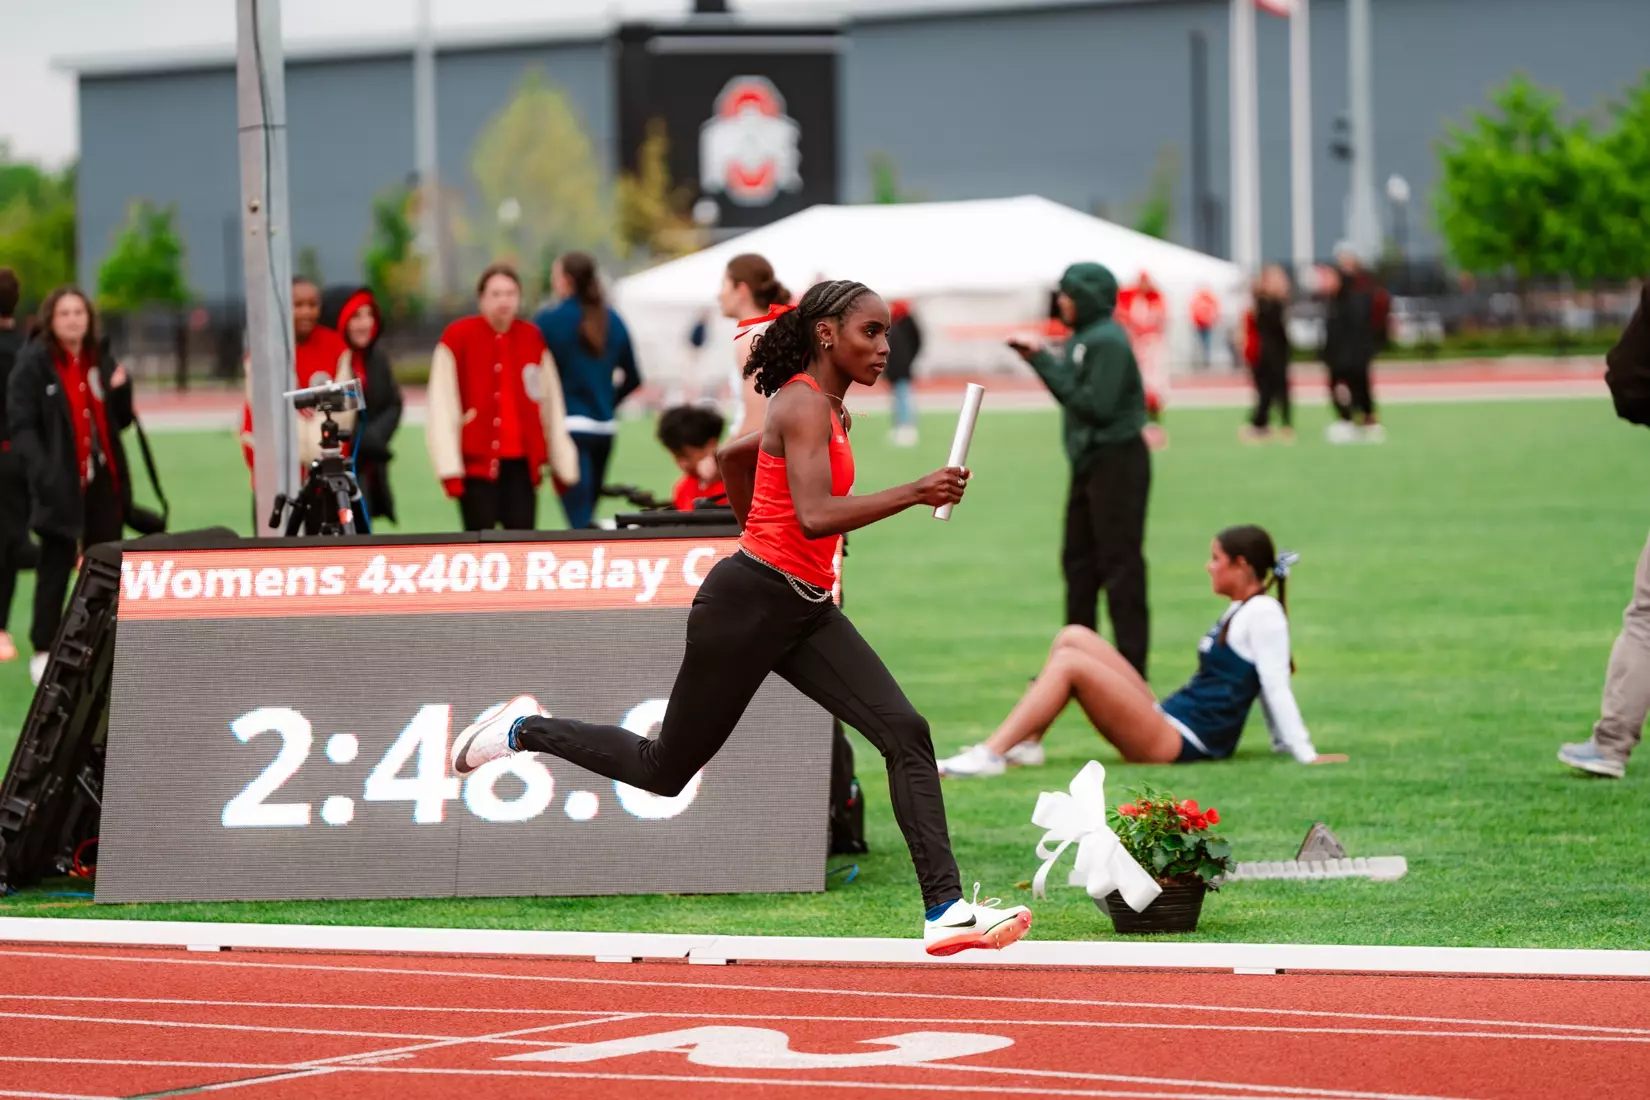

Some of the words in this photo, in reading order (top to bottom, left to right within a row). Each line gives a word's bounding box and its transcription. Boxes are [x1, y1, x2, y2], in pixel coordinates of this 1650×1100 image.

[121, 560, 346, 601] Womens
[357, 553, 511, 595] 4x400
[524, 545, 669, 603] Relay
